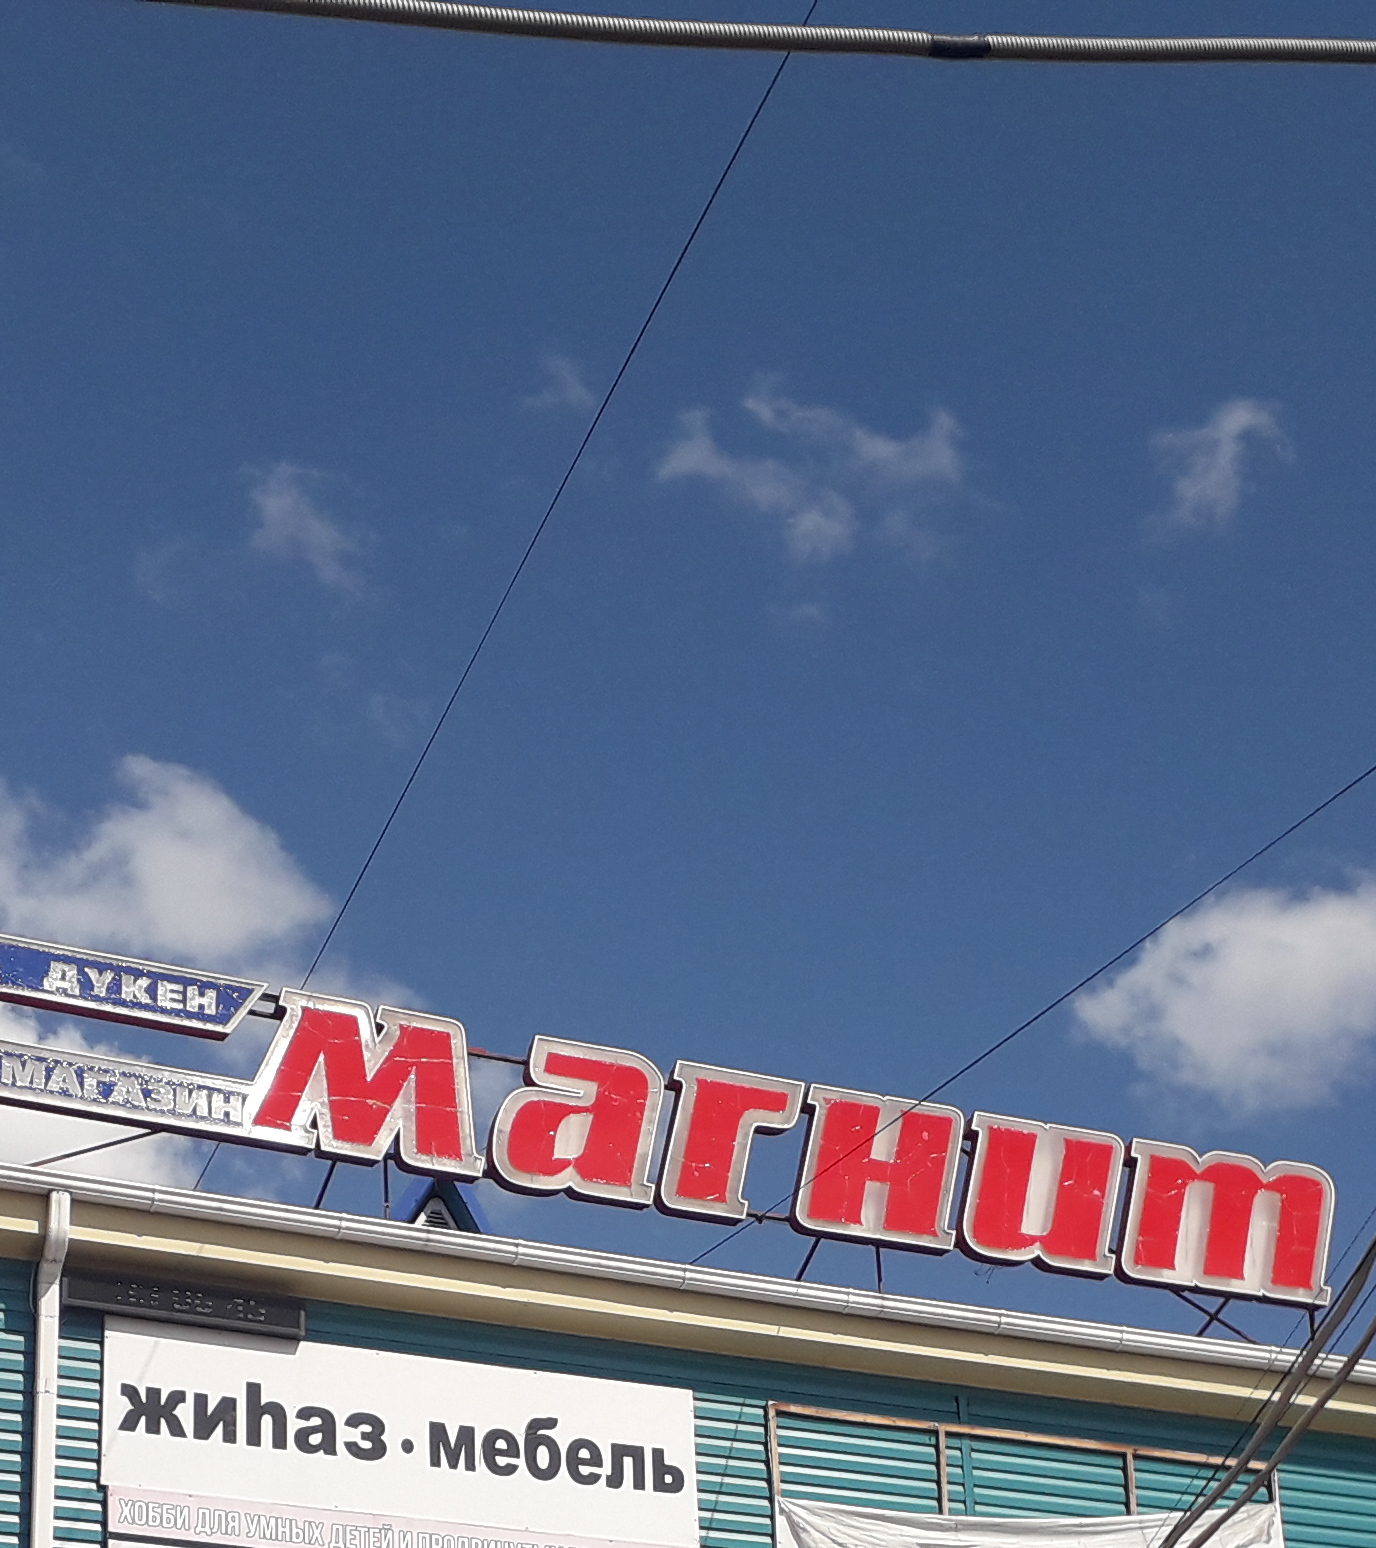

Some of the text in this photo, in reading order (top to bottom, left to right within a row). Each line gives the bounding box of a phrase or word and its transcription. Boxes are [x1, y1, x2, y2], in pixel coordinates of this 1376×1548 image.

[428, 1417, 686, 1495] мебель
[118, 1498, 191, 1531] ХОББИ
[195, 1507, 241, 1537] ДЛЯ
[245, 1512, 325, 1547] УМНЫХ
